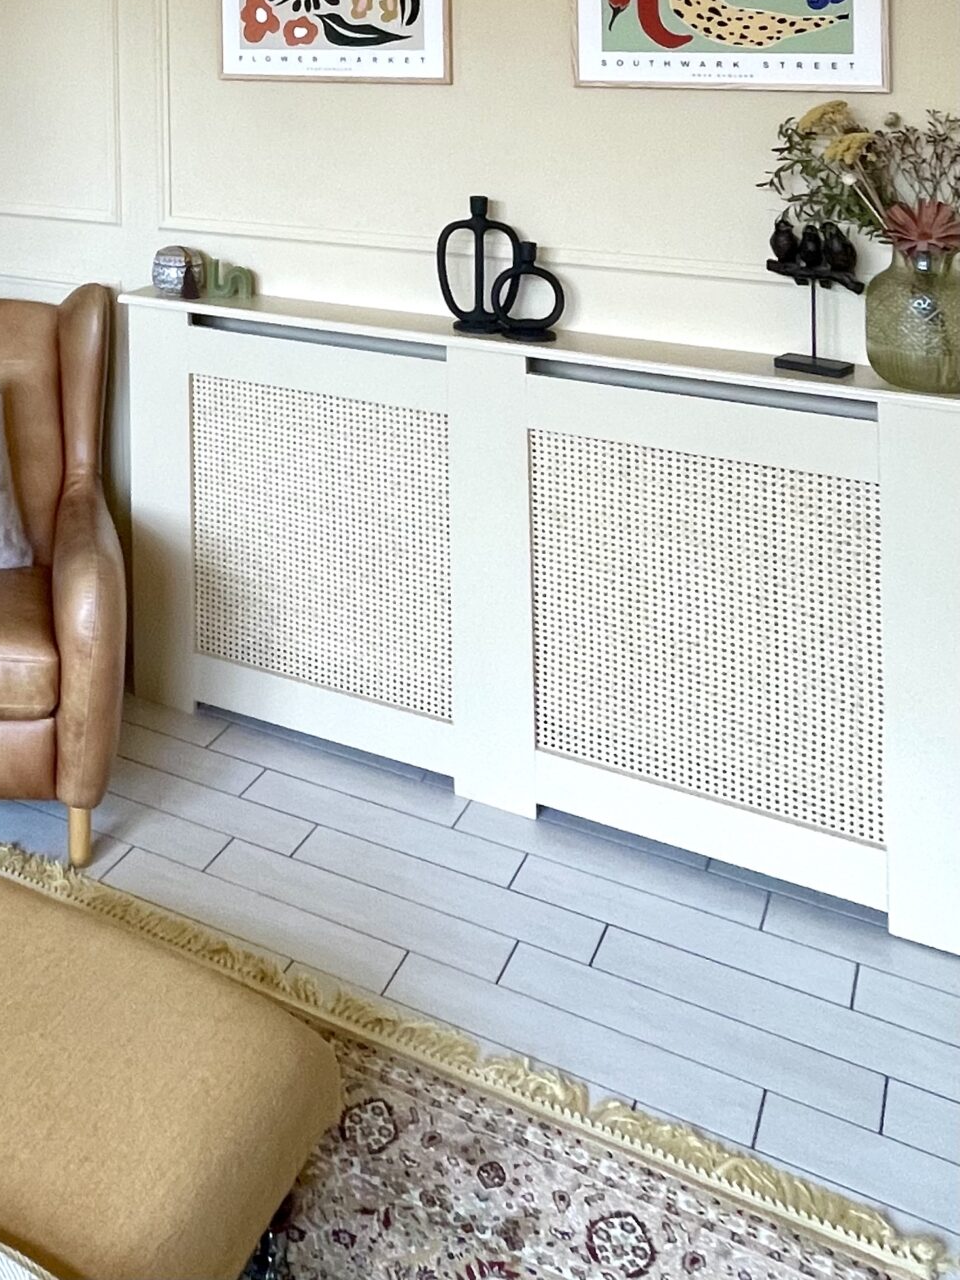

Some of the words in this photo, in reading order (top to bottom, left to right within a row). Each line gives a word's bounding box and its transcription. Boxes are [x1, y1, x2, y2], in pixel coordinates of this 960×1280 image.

[239, 55, 318, 64] FLOWER
[340, 56, 425, 65] MARKET
[601, 59, 740, 69] SOUTHWARK
[762, 60, 855, 70] STREET
